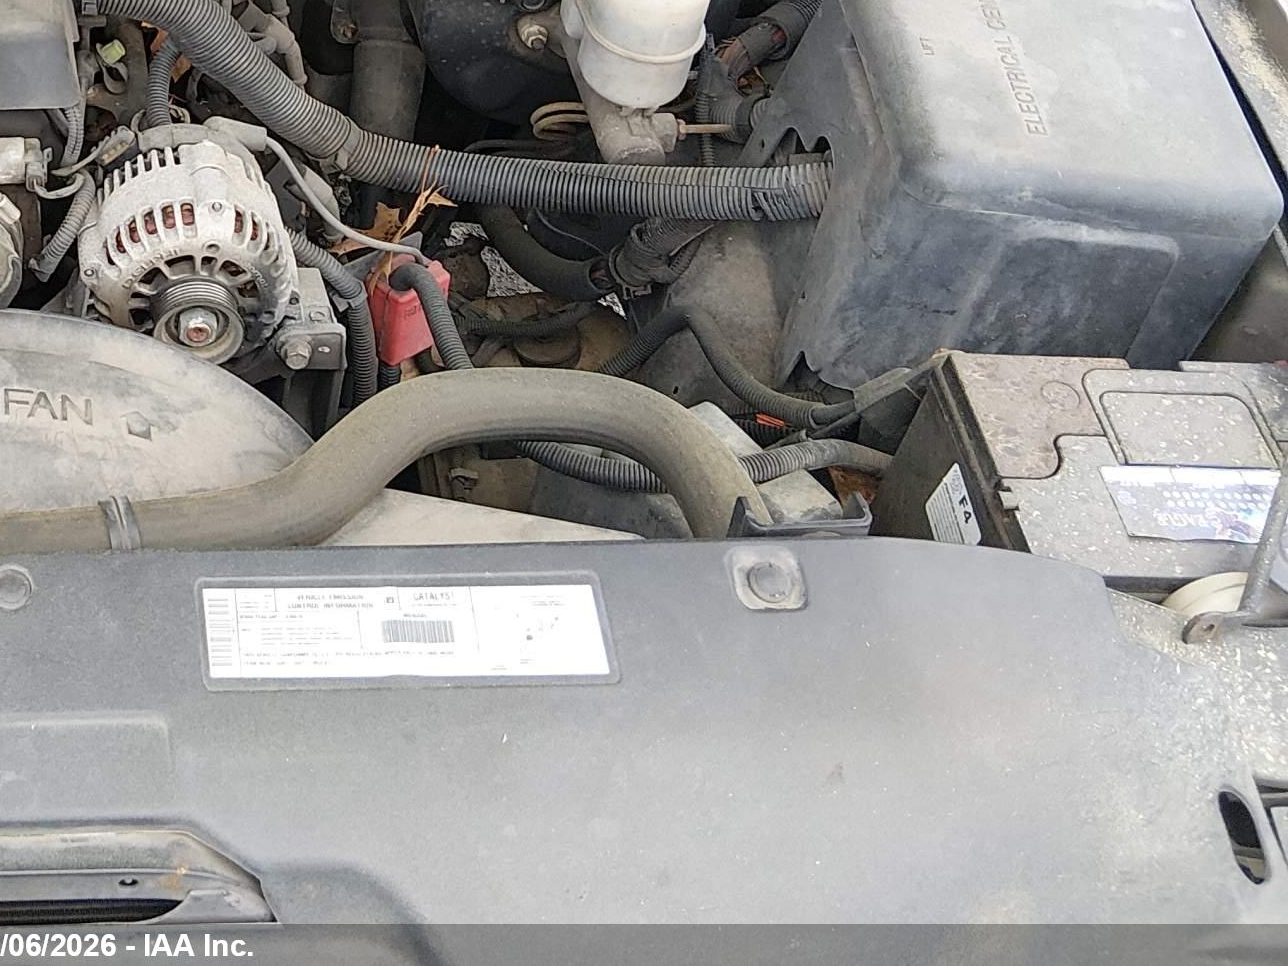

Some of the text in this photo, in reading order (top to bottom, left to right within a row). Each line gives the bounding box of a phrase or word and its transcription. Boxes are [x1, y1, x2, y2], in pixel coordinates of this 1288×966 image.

[919, 36, 935, 56] LIFT
[993, 35, 1049, 136] ELECTRICAL
[3, 387, 93, 426] FAN
